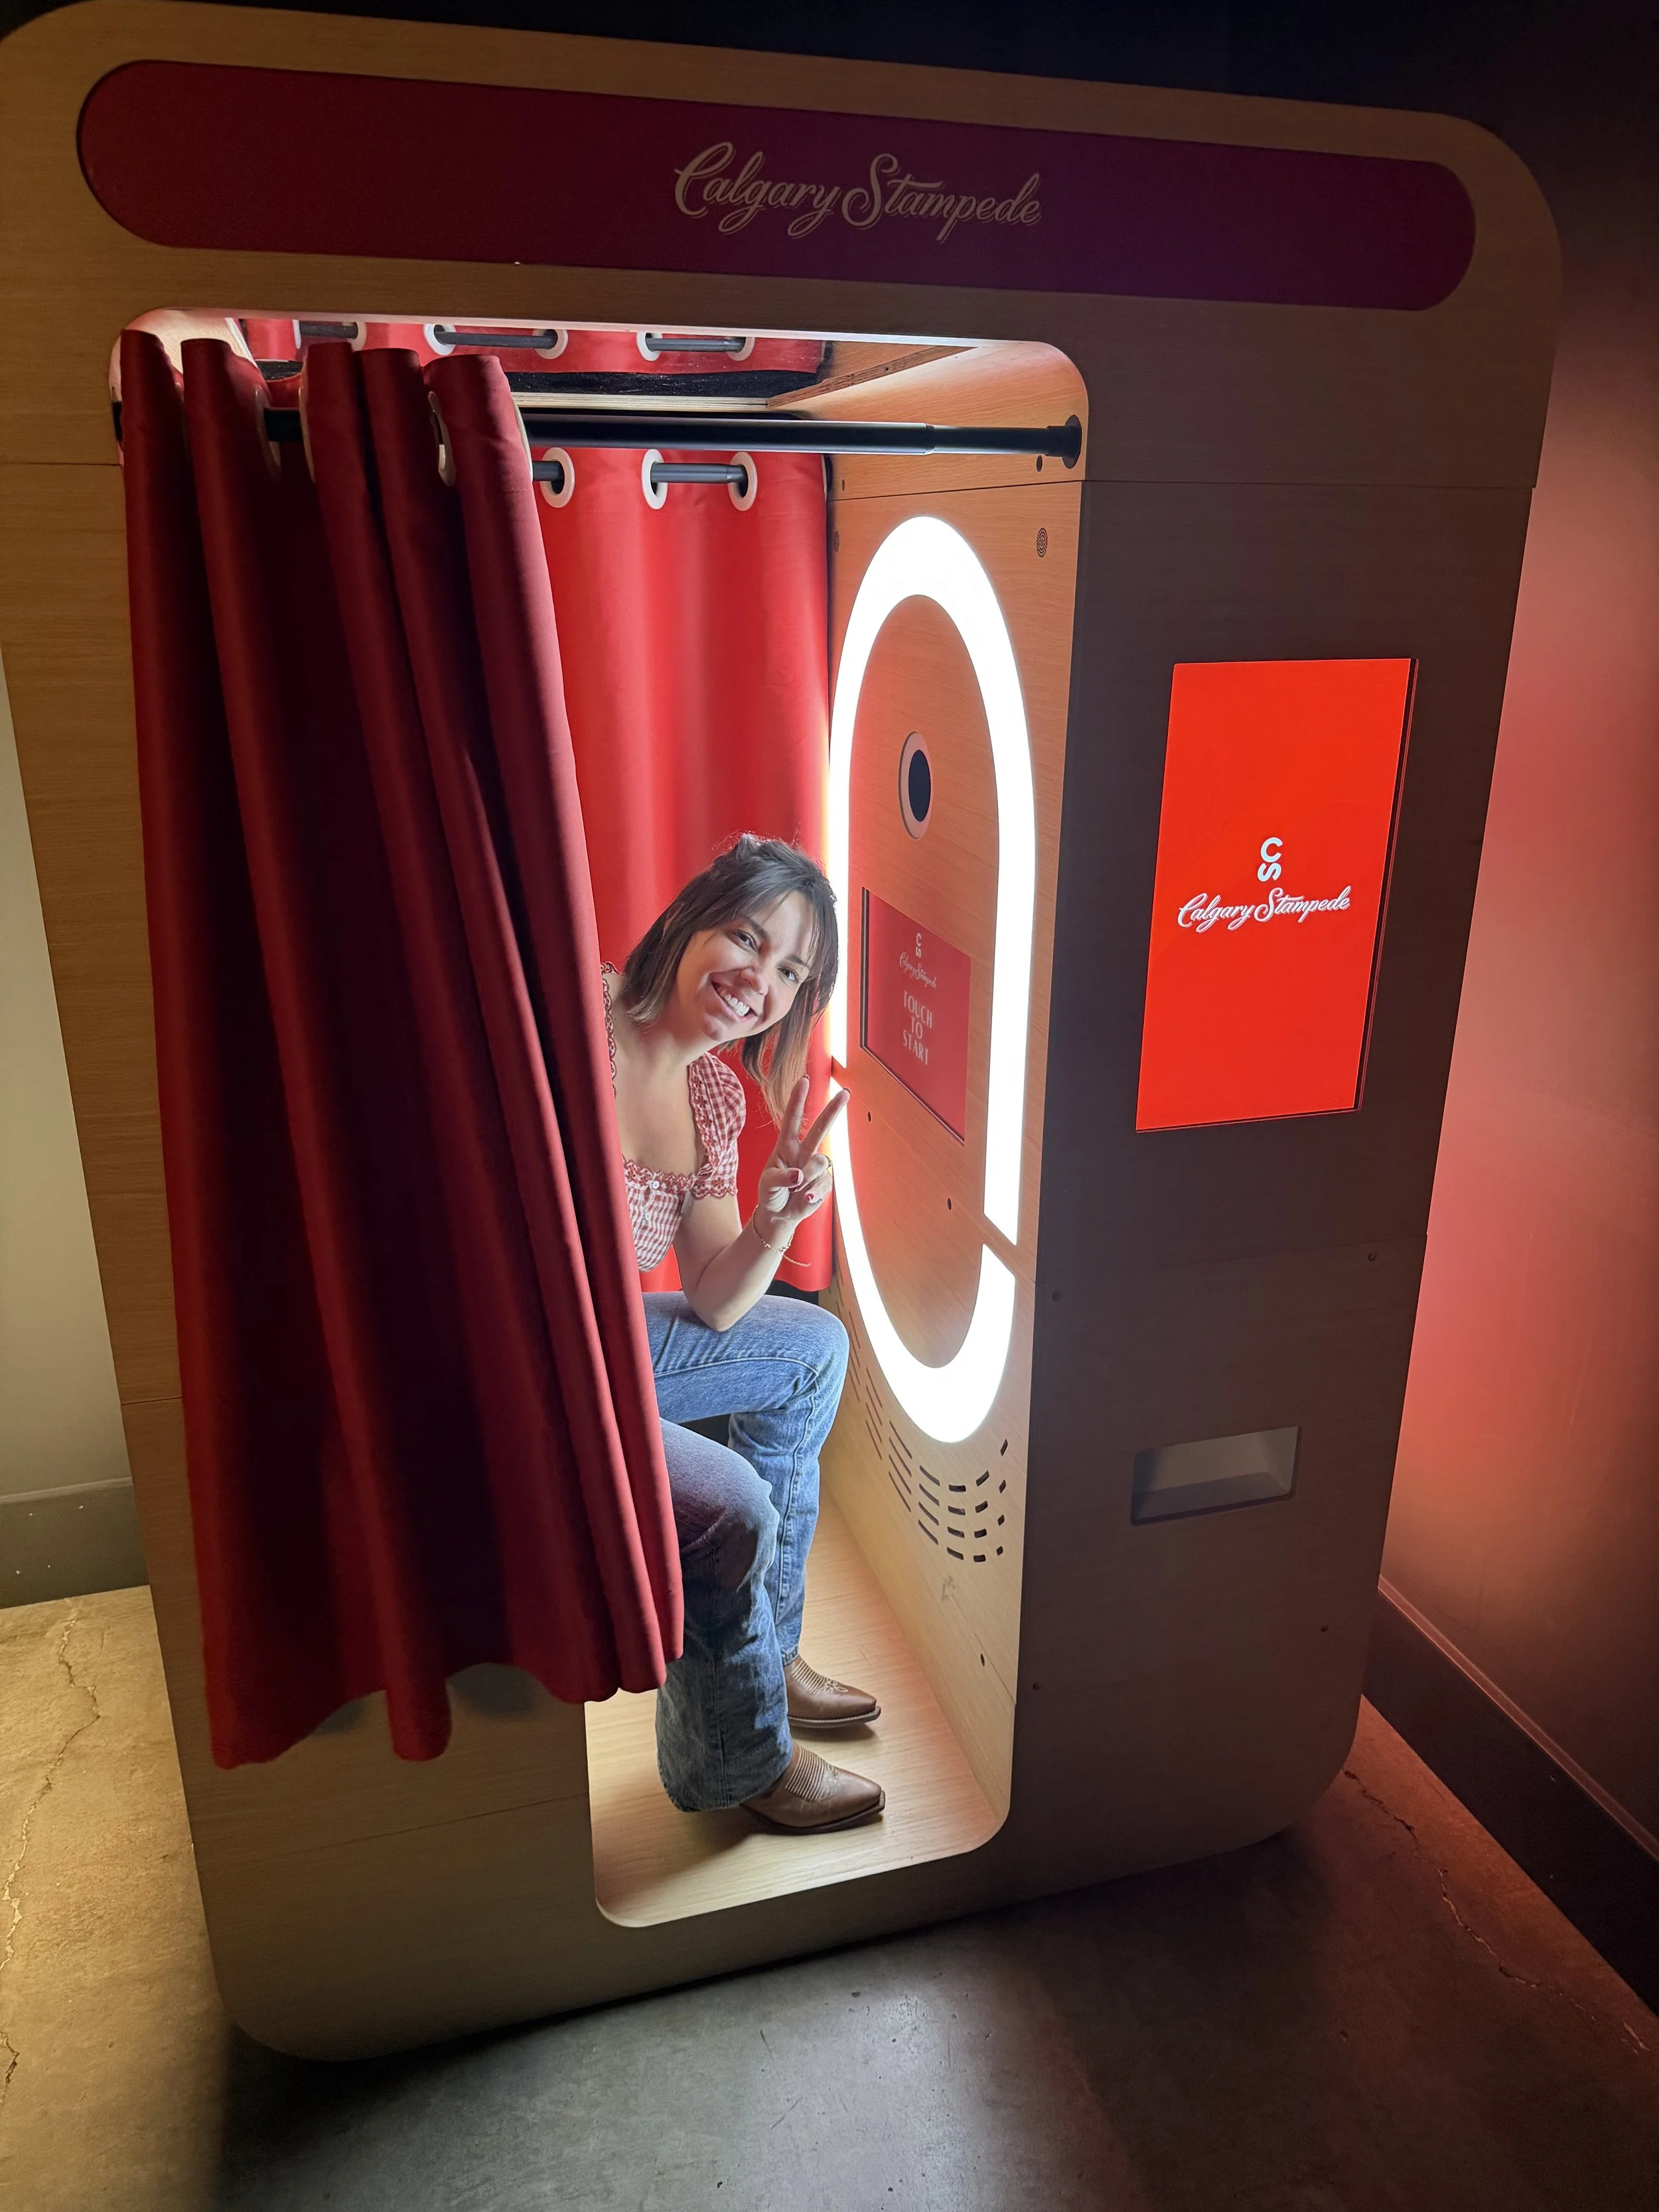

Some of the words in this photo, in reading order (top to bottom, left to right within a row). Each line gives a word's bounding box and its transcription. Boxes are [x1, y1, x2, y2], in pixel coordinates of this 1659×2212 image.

[674, 141, 840, 238] Calgary
[841, 153, 1043, 243] Stampede
[1177, 893, 1255, 933] Calgary
[1254, 885, 1352, 923] Stampede
[899, 952, 916, 979] Calgary
[915, 962, 937, 988] Stampede
[903, 991, 932, 1029] TOUCH
[910, 1017, 923, 1040] TO
[903, 1029, 929, 1065] START
